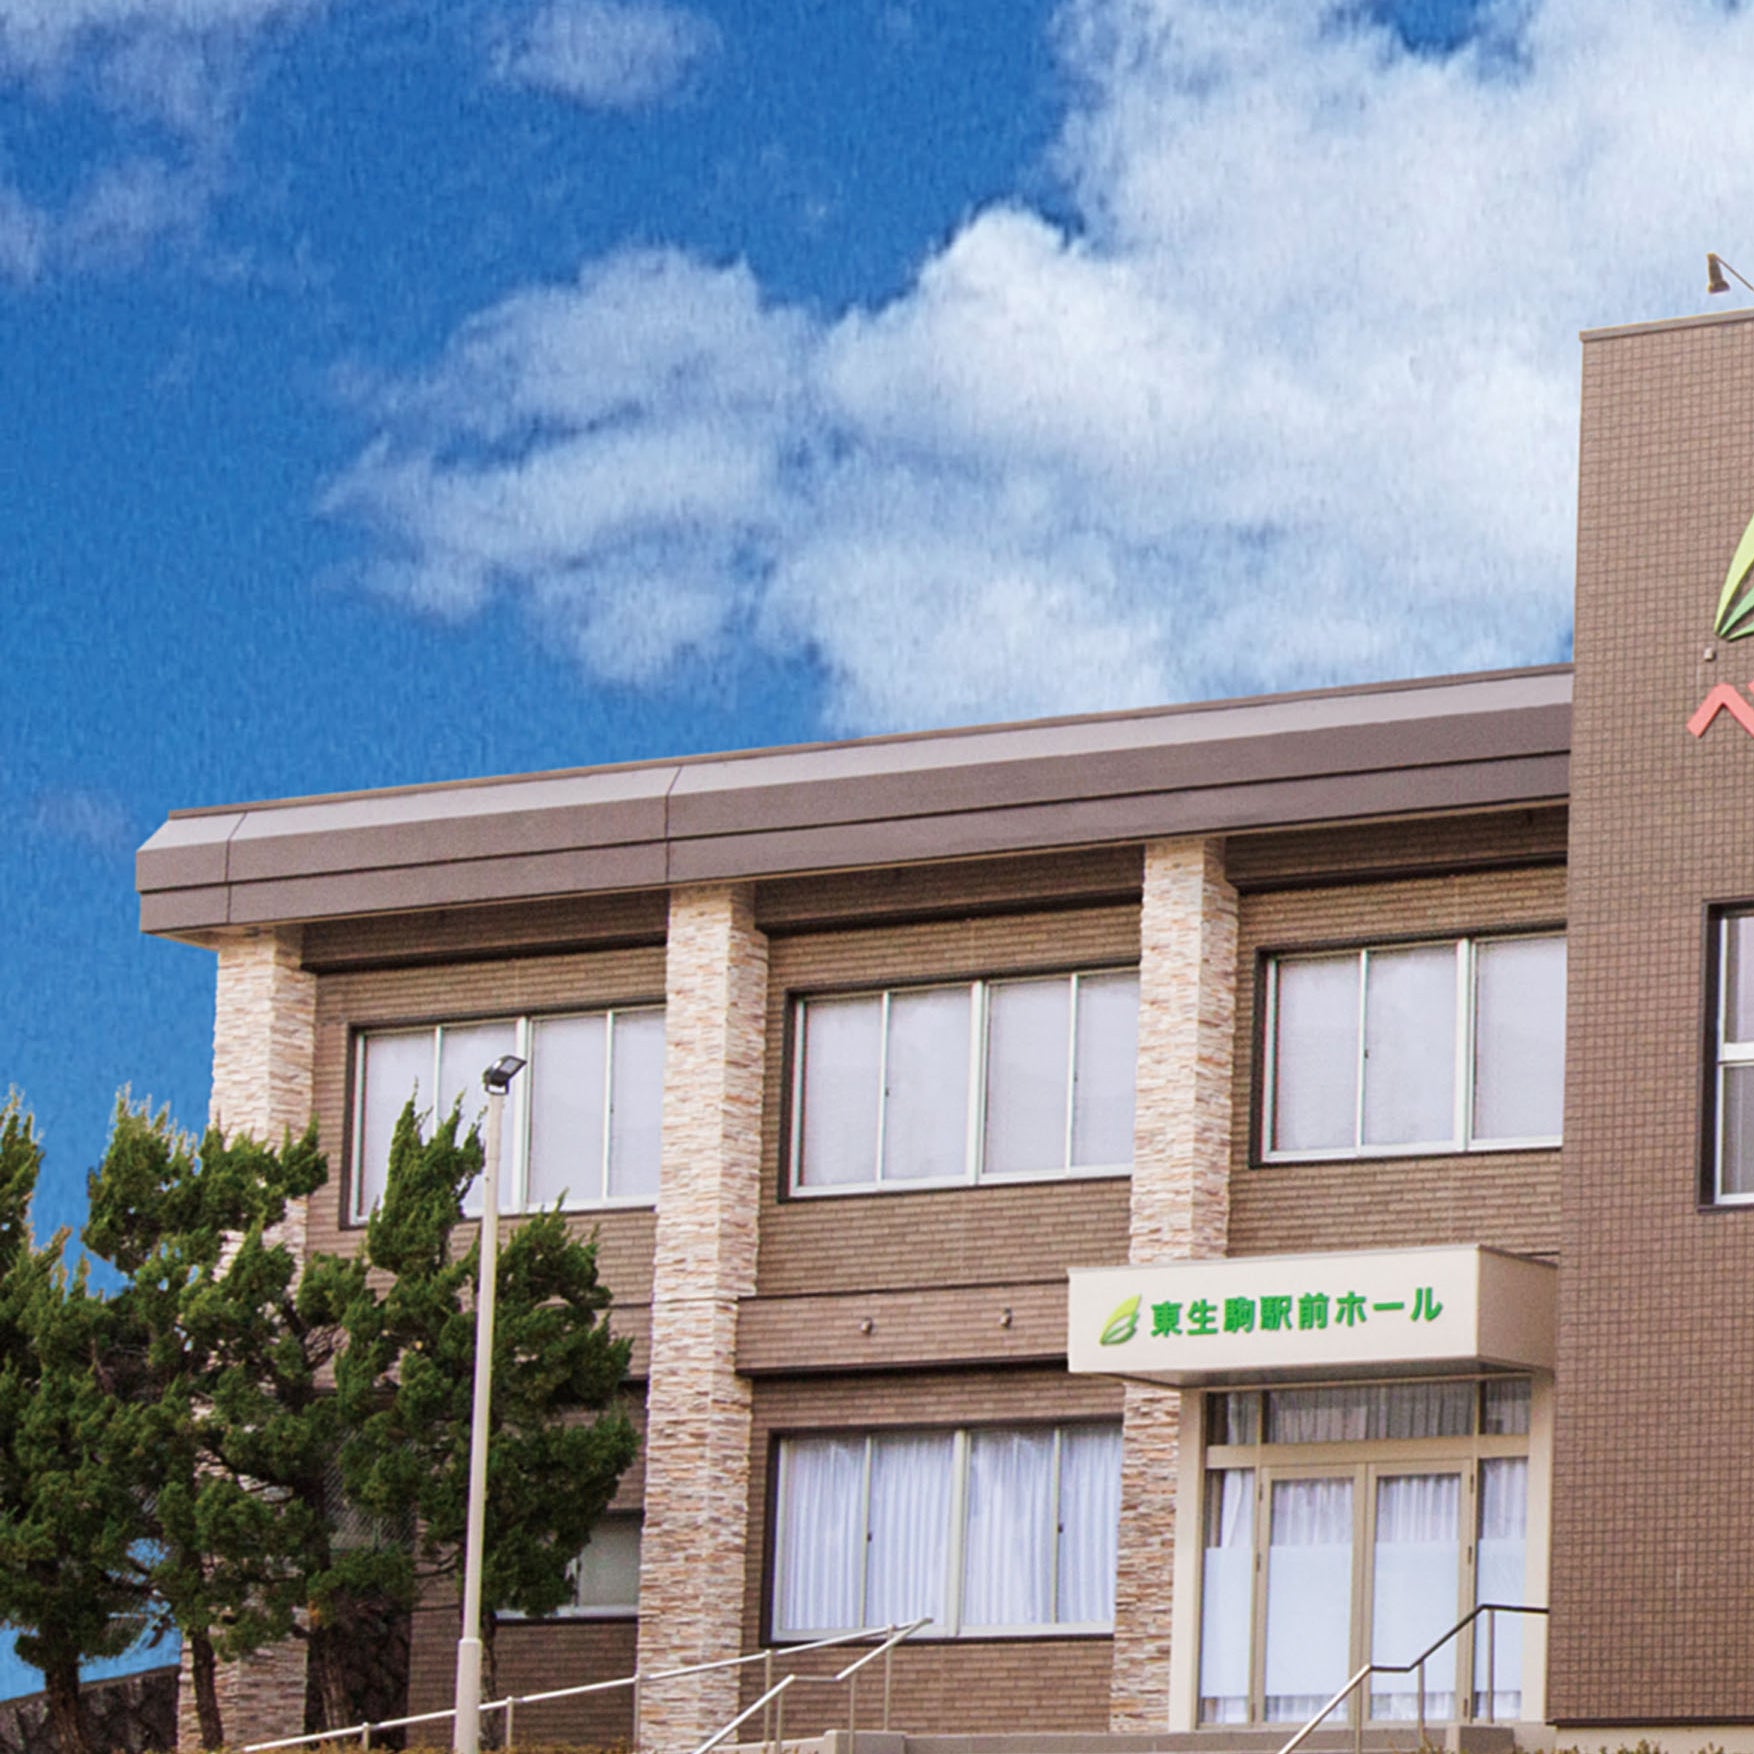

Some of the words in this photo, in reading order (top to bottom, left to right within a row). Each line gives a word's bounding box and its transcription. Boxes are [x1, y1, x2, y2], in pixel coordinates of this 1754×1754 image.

[1151, 1287, 1443, 1337] 東生駒駅前ホール
